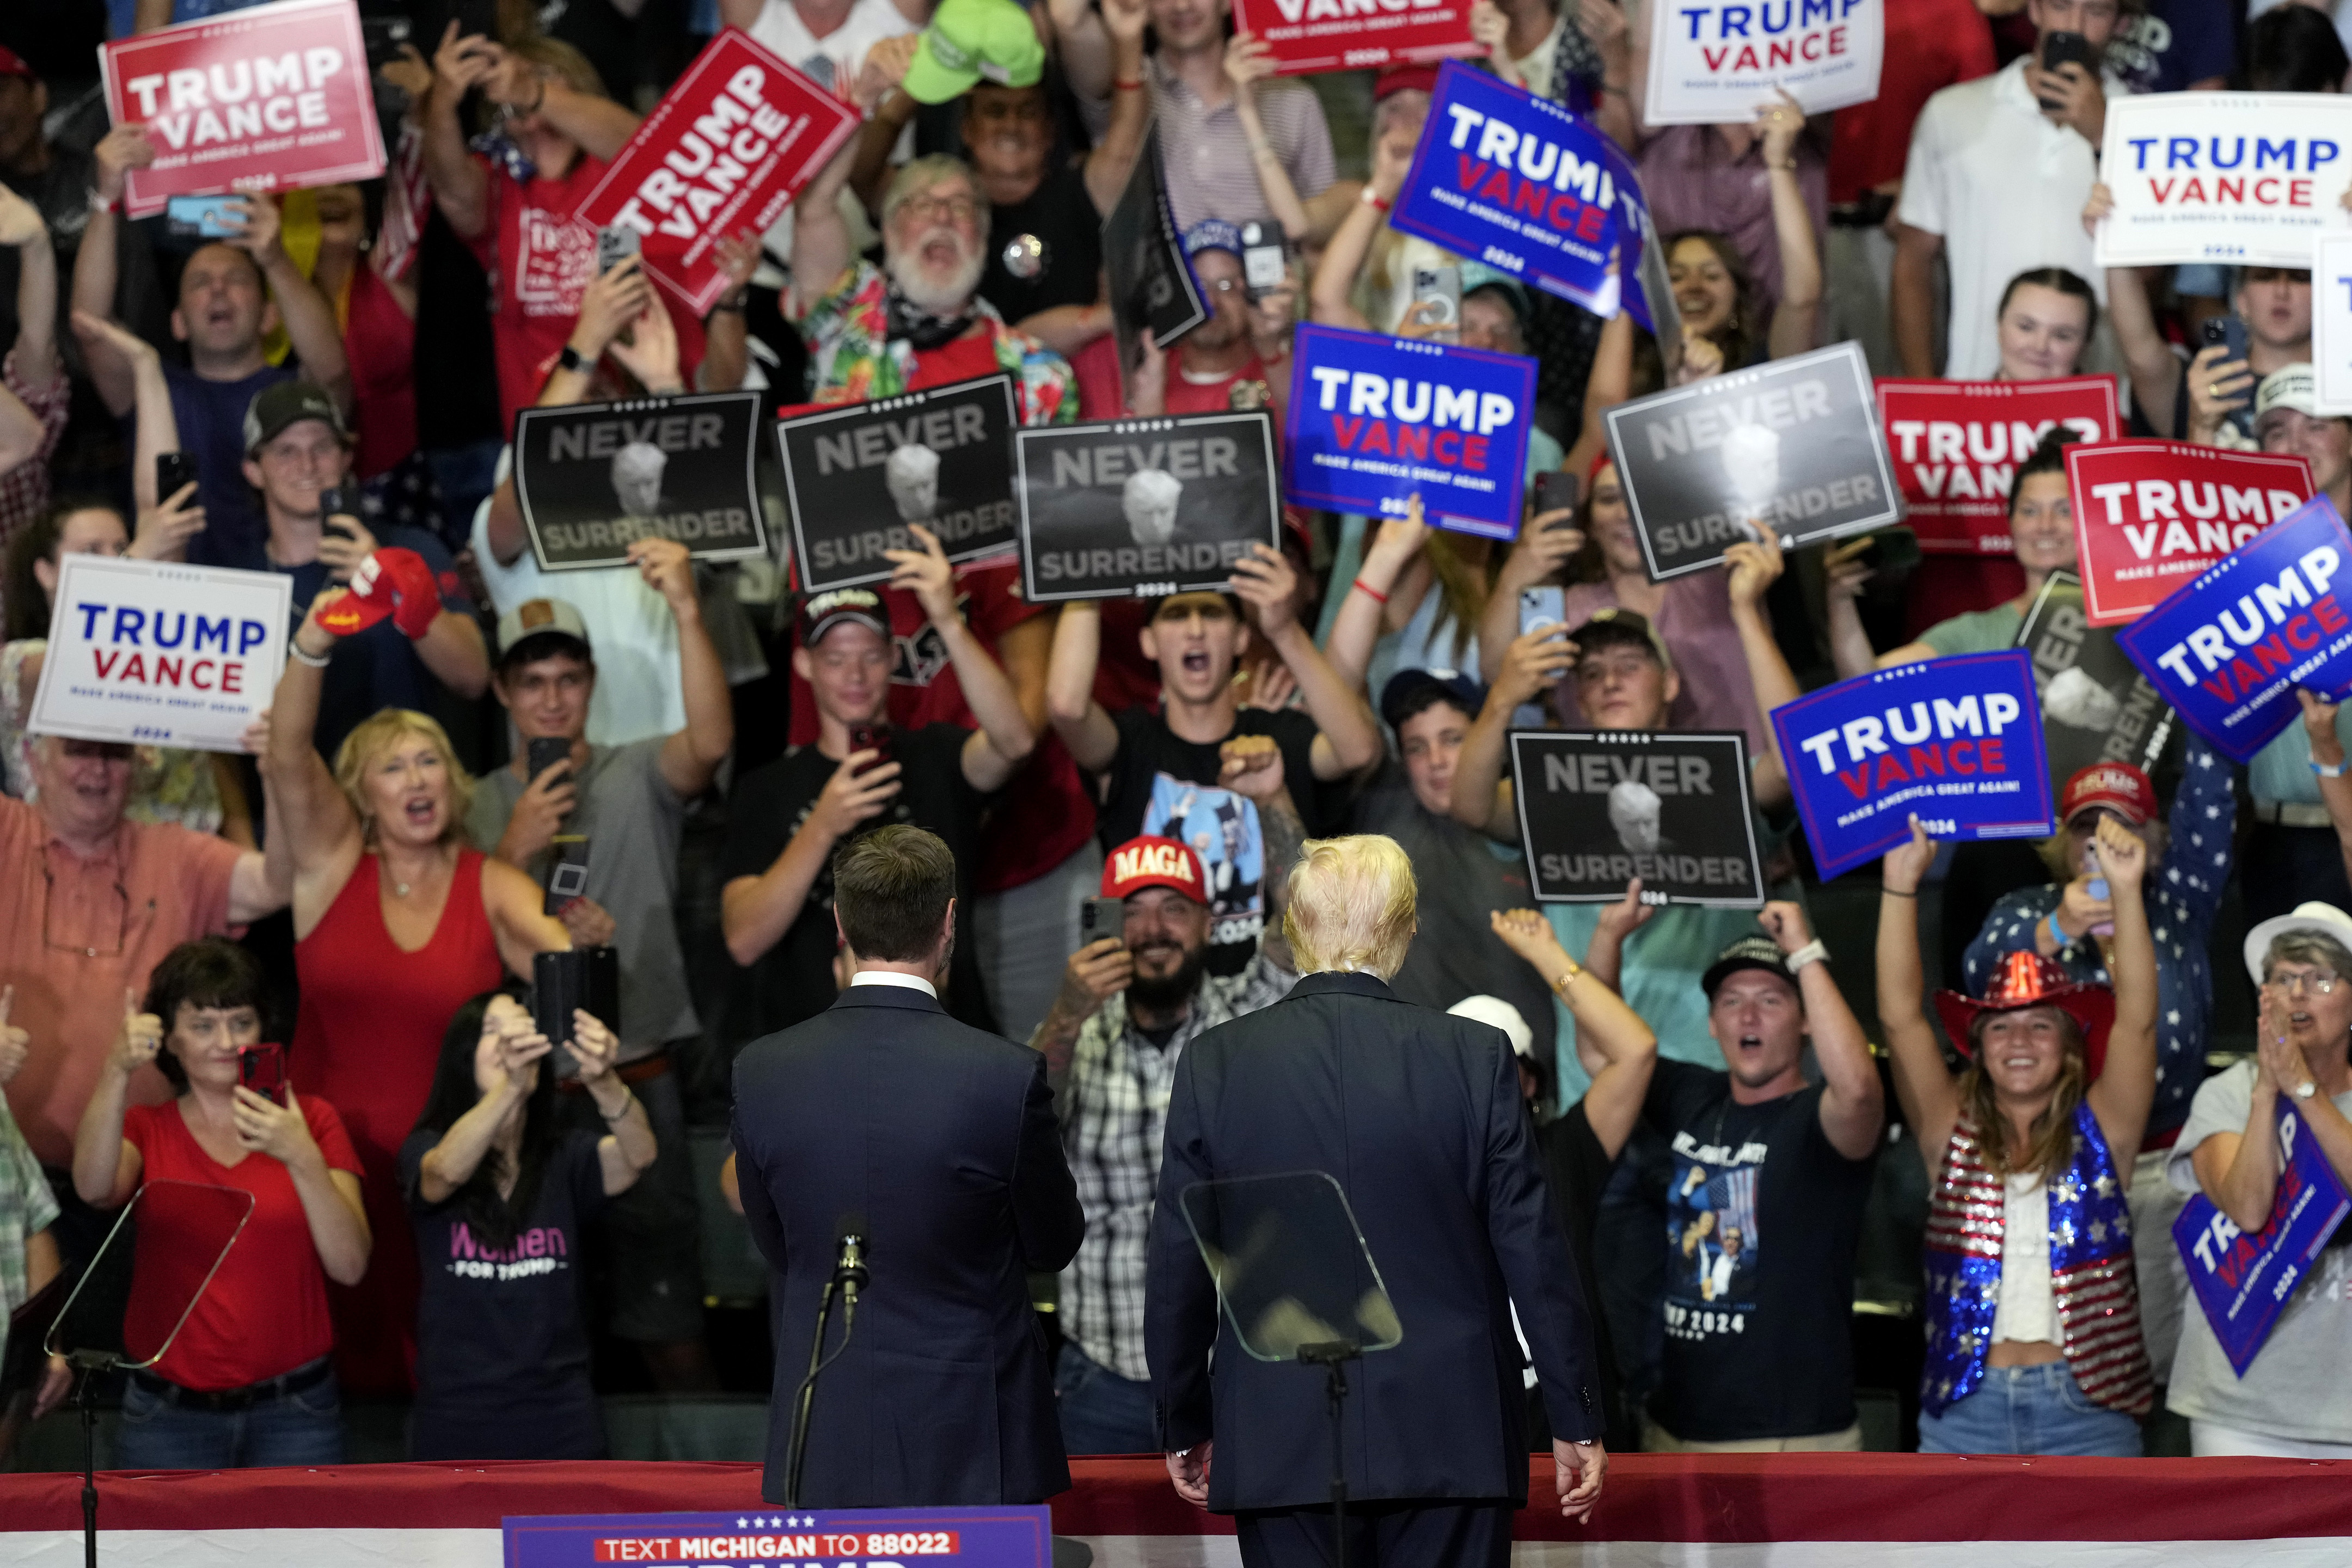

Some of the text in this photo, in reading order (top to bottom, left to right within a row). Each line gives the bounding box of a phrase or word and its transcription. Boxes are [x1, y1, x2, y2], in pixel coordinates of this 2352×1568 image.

[1702, 24, 1847, 73] VANCE
[127, 46, 343, 118] TRUMP
[158, 91, 330, 150] VANCE
[610, 63, 766, 237] TRUMP
[658, 101, 791, 240] VANCE
[2128, 137, 2339, 172] TRUMP
[1457, 151, 1607, 243] VANCE
[2149, 177, 2314, 207] VANCE
[1312, 365, 1515, 436] TRUMP
[1646, 378, 1832, 461] NEVER
[549, 413, 724, 462] NEVER
[814, 403, 987, 475] NEVER
[1332, 413, 1490, 472] VANCE
[1052, 437, 1238, 488] NEVER
[1913, 463, 2014, 499] VAN
[2091, 479, 2304, 525] TRUMP
[543, 509, 751, 551] SURRENDER
[813, 499, 1017, 568] SURRNDER
[2123, 519, 2265, 560] VANC
[2115, 565, 2154, 581] MAKE
[78, 603, 266, 656] TRUMP
[2156, 544, 2340, 687] TRUMP
[93, 649, 243, 693] VANCE
[2202, 593, 2349, 704] VANCE
[2289, 650, 2328, 683] GREAT
[1801, 692, 2020, 775] TRUMP
[1543, 752, 1714, 795] NEVER
[1837, 738, 2007, 800] VANCE
[1837, 780, 2020, 828] MAKE AMERICA GREAT AGAIN!
[1114, 844, 1196, 885] MAGA
[1539, 854, 1748, 885] SURRENDER
[1640, 890, 1668, 906] 024
[2193, 1111, 2297, 1275] TRP
[2218, 1161, 2301, 1289] VANCE
[455, 1257, 556, 1281] FOR TRUMP
[2273, 1264, 2298, 1302] 2024
[1690, 1310, 1744, 1333] 2024
[604, 1532, 951, 1560] TEXT MICHIGAN TO 88022
